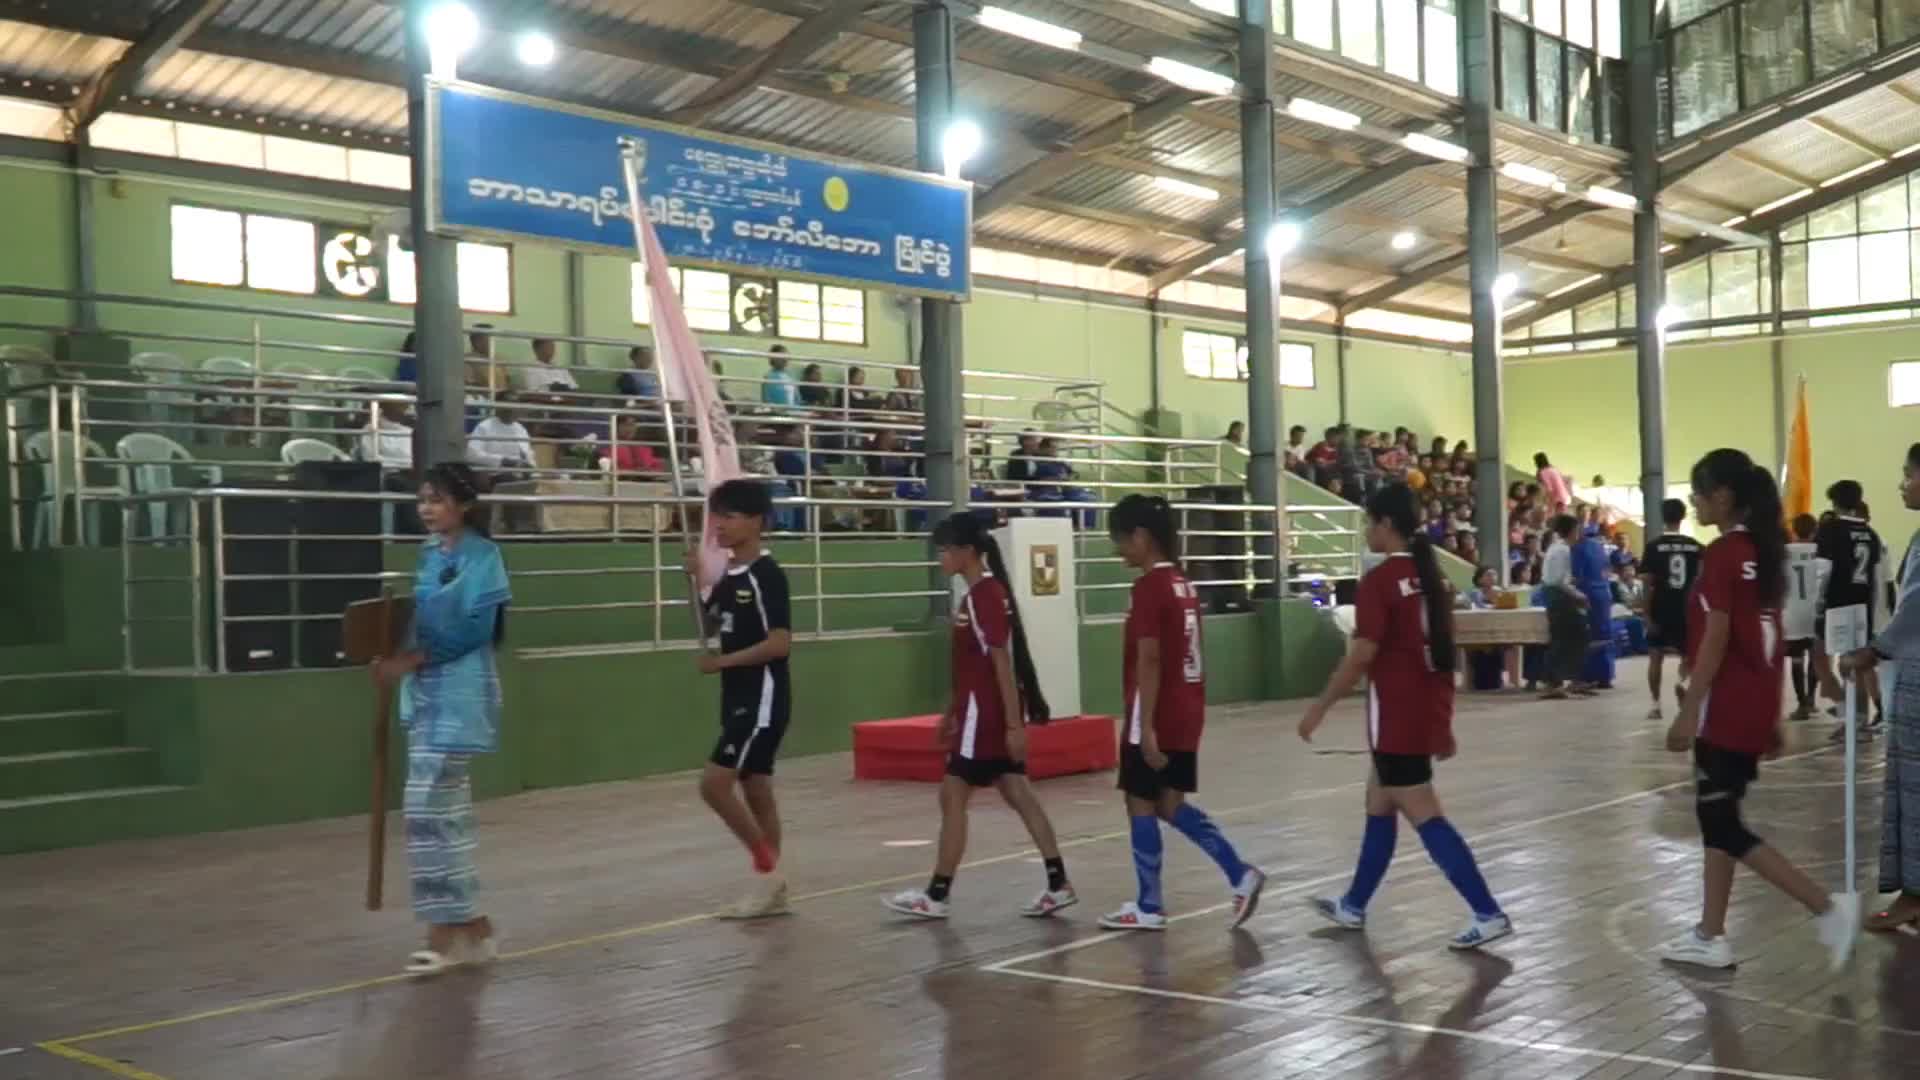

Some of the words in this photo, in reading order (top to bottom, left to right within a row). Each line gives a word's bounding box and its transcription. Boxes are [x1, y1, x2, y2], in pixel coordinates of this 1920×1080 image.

[732, 214, 881, 256] ဘော်လီဘော
[895, 233, 951, 278] ပြိုင်ပွဲ
[1669, 553, 1687, 589] 9
[1852, 544, 1870, 583] 2
